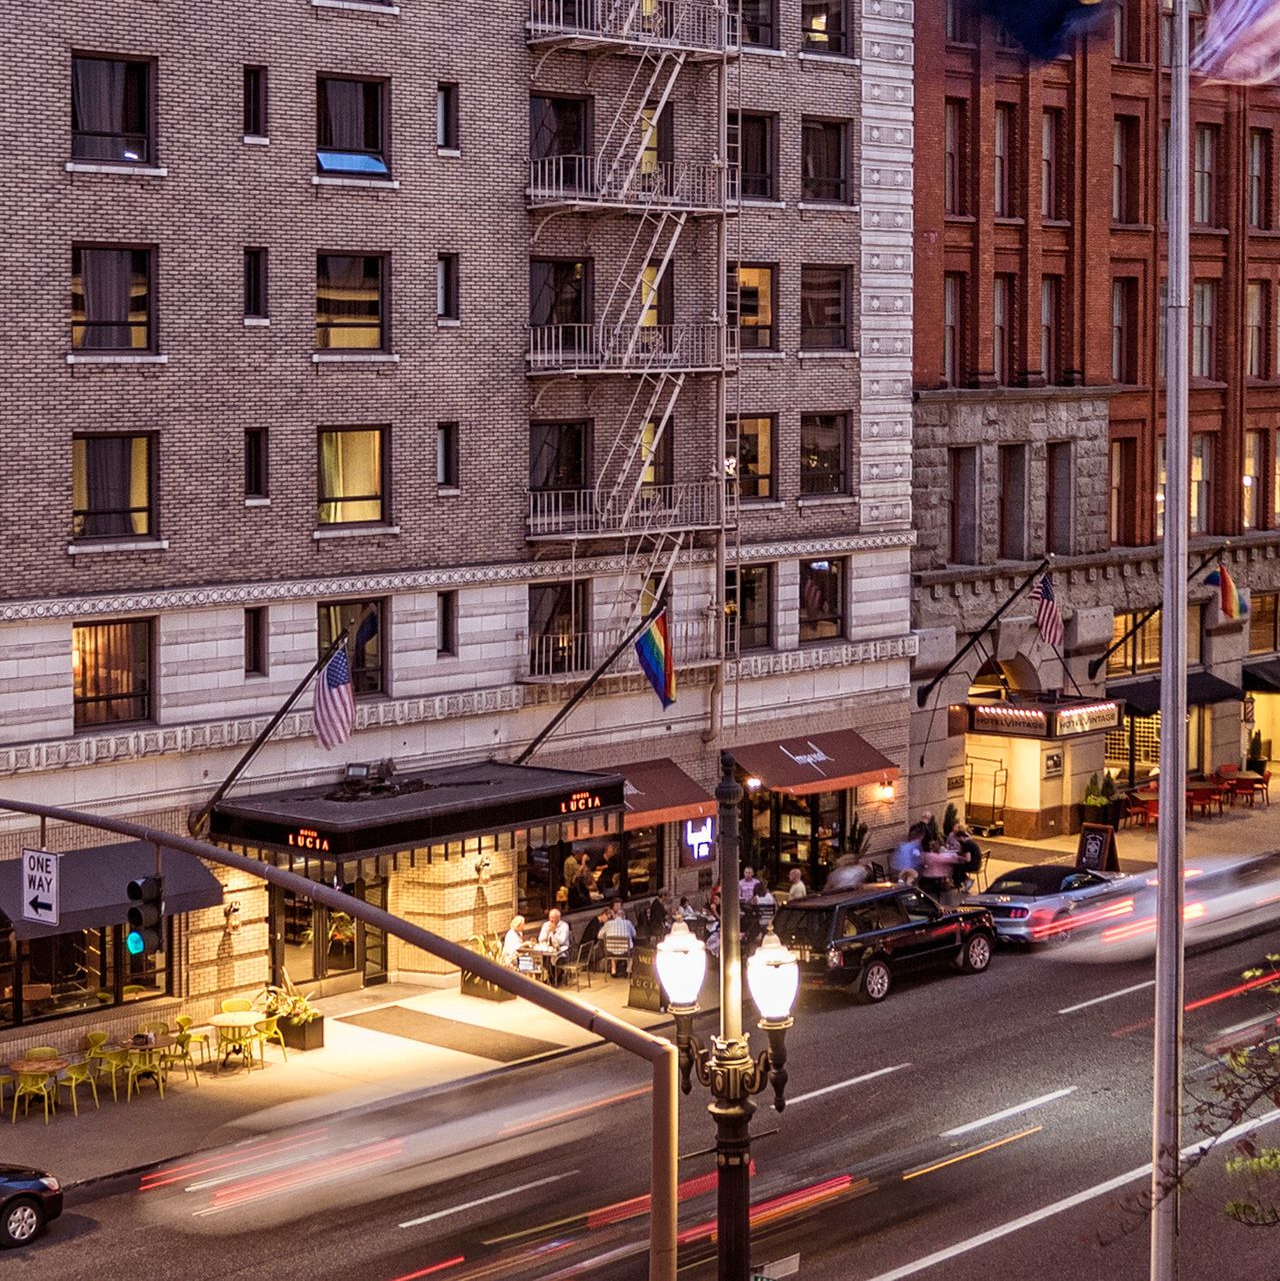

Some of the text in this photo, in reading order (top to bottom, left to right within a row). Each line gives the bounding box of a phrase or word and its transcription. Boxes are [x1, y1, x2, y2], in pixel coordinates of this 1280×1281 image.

[561, 796, 601, 813] LUCIA
[288, 833, 329, 851] LUCIA
[28, 855, 52, 874] ONE
[28, 874, 53, 893] WAY
